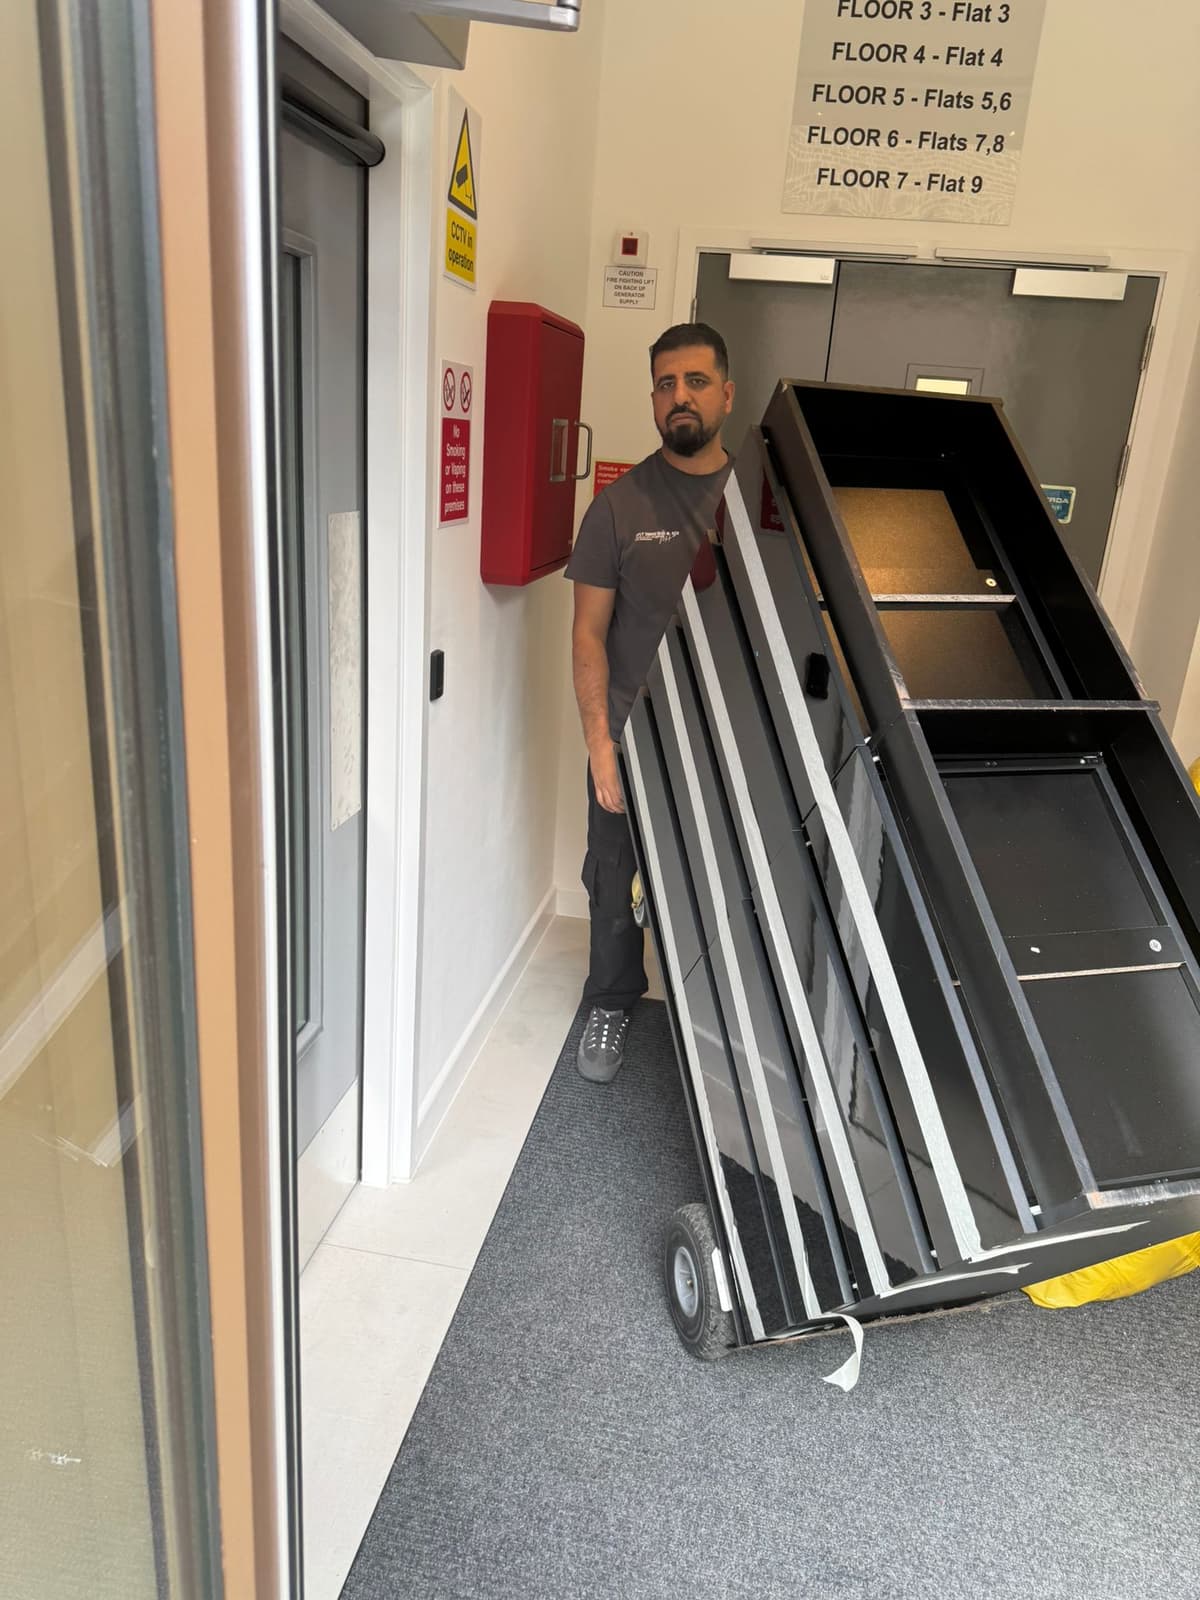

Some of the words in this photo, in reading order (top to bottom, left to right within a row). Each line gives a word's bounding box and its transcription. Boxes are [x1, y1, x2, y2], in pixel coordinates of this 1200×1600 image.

[837, 0, 913, 20] FLOOR
[920, 1, 932, 21] 3
[952, 2, 992, 23] Flat
[998, 4, 1010, 23] 3
[832, 42, 908, 64] FLOOR
[913, 45, 926, 64] 4
[945, 46, 985, 67] Flat
[990, 48, 1003, 67] 4
[812, 84, 887, 106] FLOOR
[892, 87, 905, 106] 5
[924, 89, 974, 110] Flats
[981, 91, 1012, 114] 5,6
[807, 126, 881, 148] FLOOR
[887, 130, 900, 148] 6
[918, 131, 968, 152] Flats
[975, 134, 1005, 156] 7,8
[816, 168, 890, 189] FLOOR
[896, 172, 909, 189] 7
[927, 173, 965, 193] Flat
[971, 175, 983, 194] 9
[451, 221, 467, 245] CCTV
[467, 232, 473, 249] in
[448, 248, 474, 273] operation
[619, 277, 643, 285] FIGHTING
[453, 424, 460, 438] No
[446, 443, 466, 460] Smoking
[445, 465, 451, 476] or
[451, 462, 466, 478] Vaping
[445, 483, 452, 494] on
[452, 481, 465, 493] these
[444, 499, 465, 516] premises
